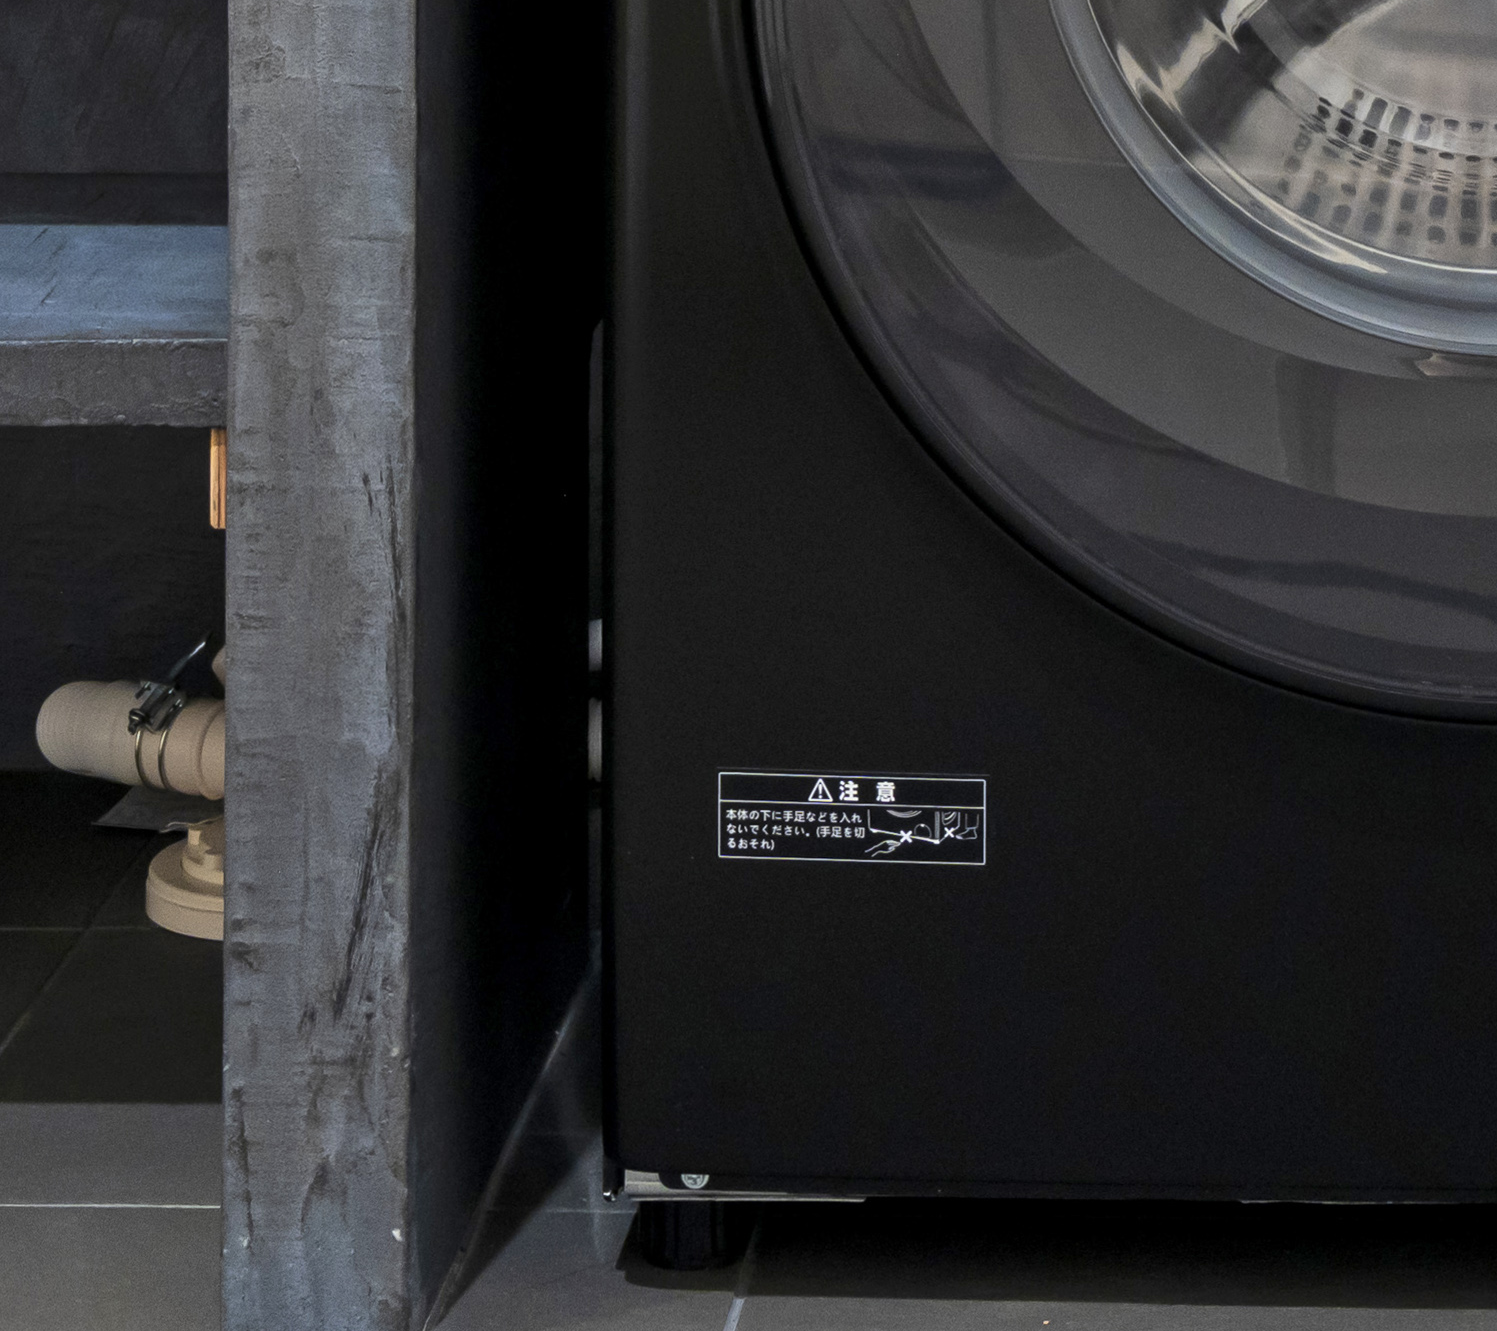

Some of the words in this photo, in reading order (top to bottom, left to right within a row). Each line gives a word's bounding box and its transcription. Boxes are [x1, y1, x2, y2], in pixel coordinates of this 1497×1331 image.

[839, 780, 895, 802] 注意
[726, 808, 862, 823] 本体の下に手足などを入れ
[727, 837, 774, 849] るおそれ)
